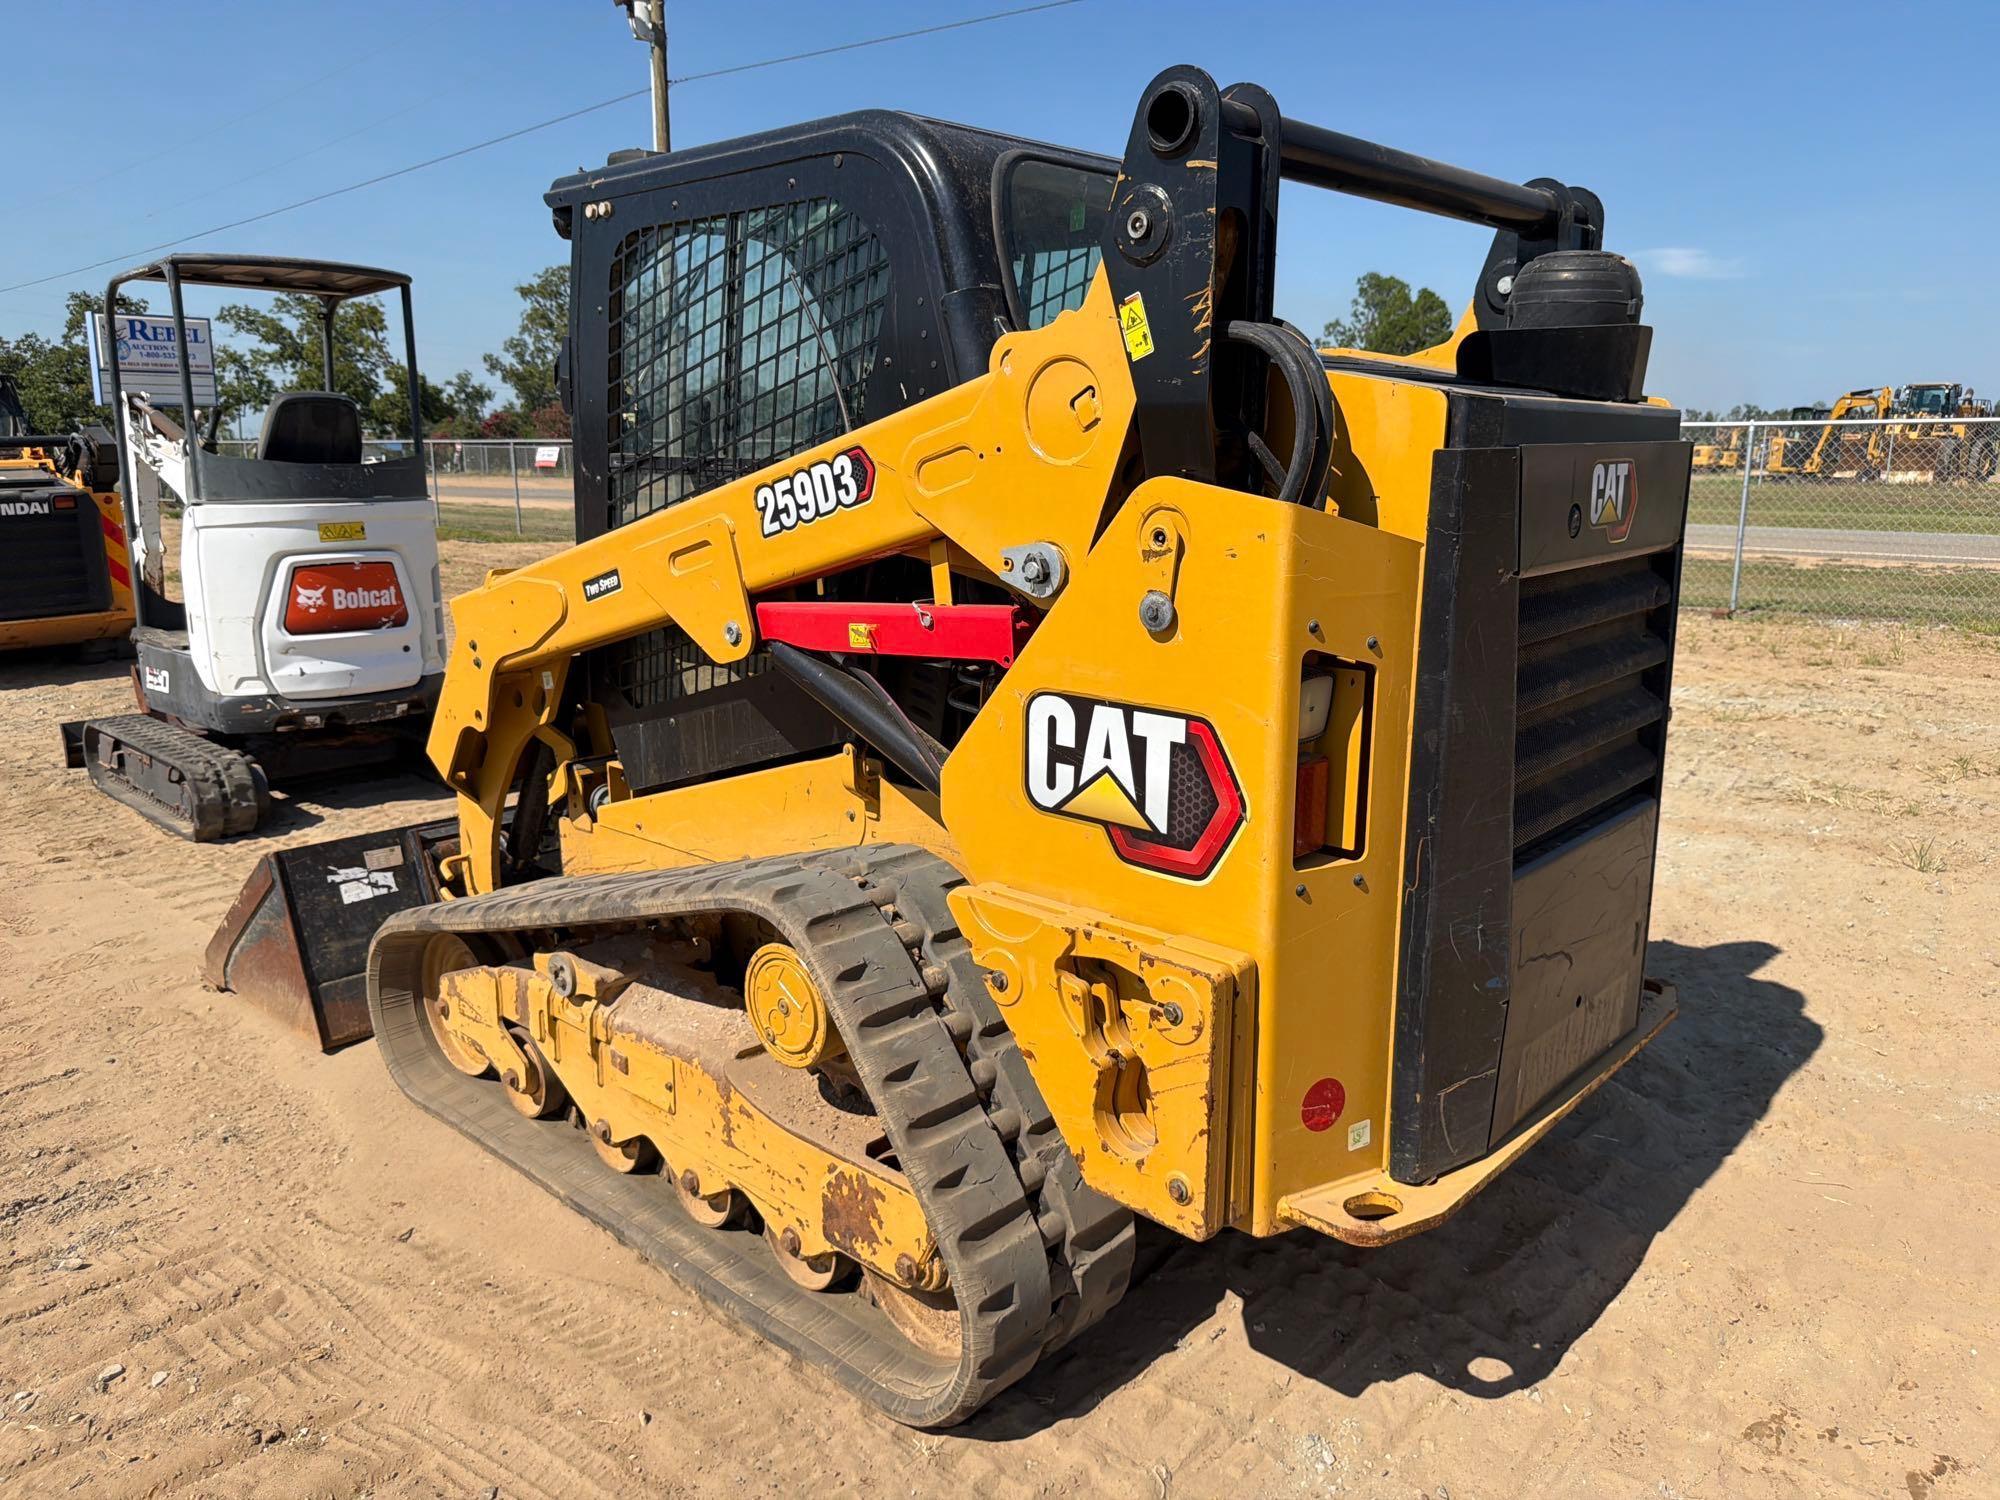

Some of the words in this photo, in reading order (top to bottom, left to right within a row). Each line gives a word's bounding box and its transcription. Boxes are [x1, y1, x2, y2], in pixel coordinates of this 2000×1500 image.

[132, 343, 169, 352] AUCTION
[756, 454, 858, 536] 259D3
[1590, 463, 1629, 525] CAT
[332, 585, 398, 610] Bobcat
[1028, 693, 1187, 836] CAT
